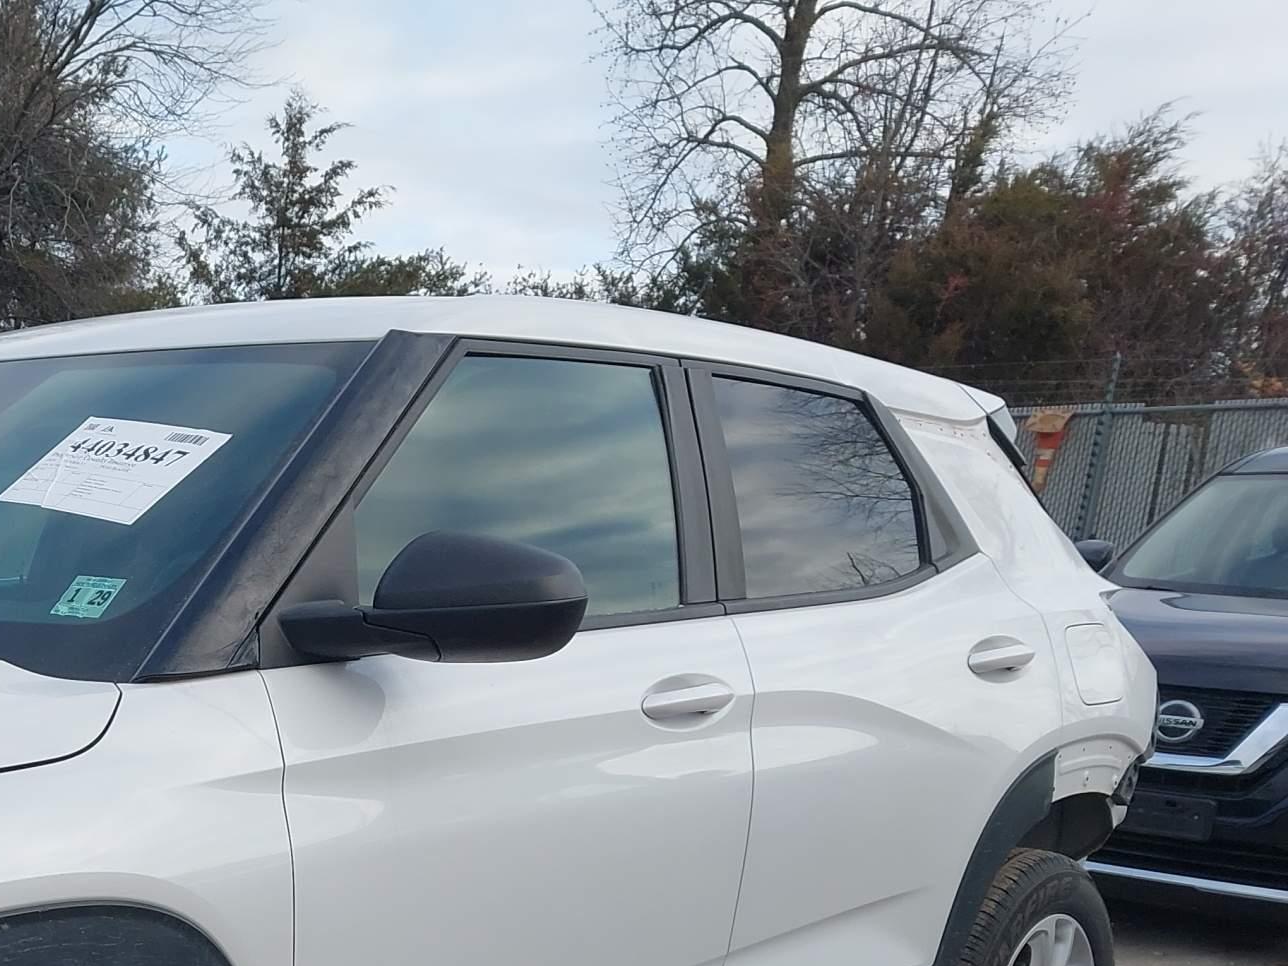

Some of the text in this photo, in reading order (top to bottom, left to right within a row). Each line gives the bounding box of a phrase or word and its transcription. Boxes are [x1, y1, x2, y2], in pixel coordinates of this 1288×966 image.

[69, 438, 191, 467] 44034847
[67, 588, 112, 606] 1 29
